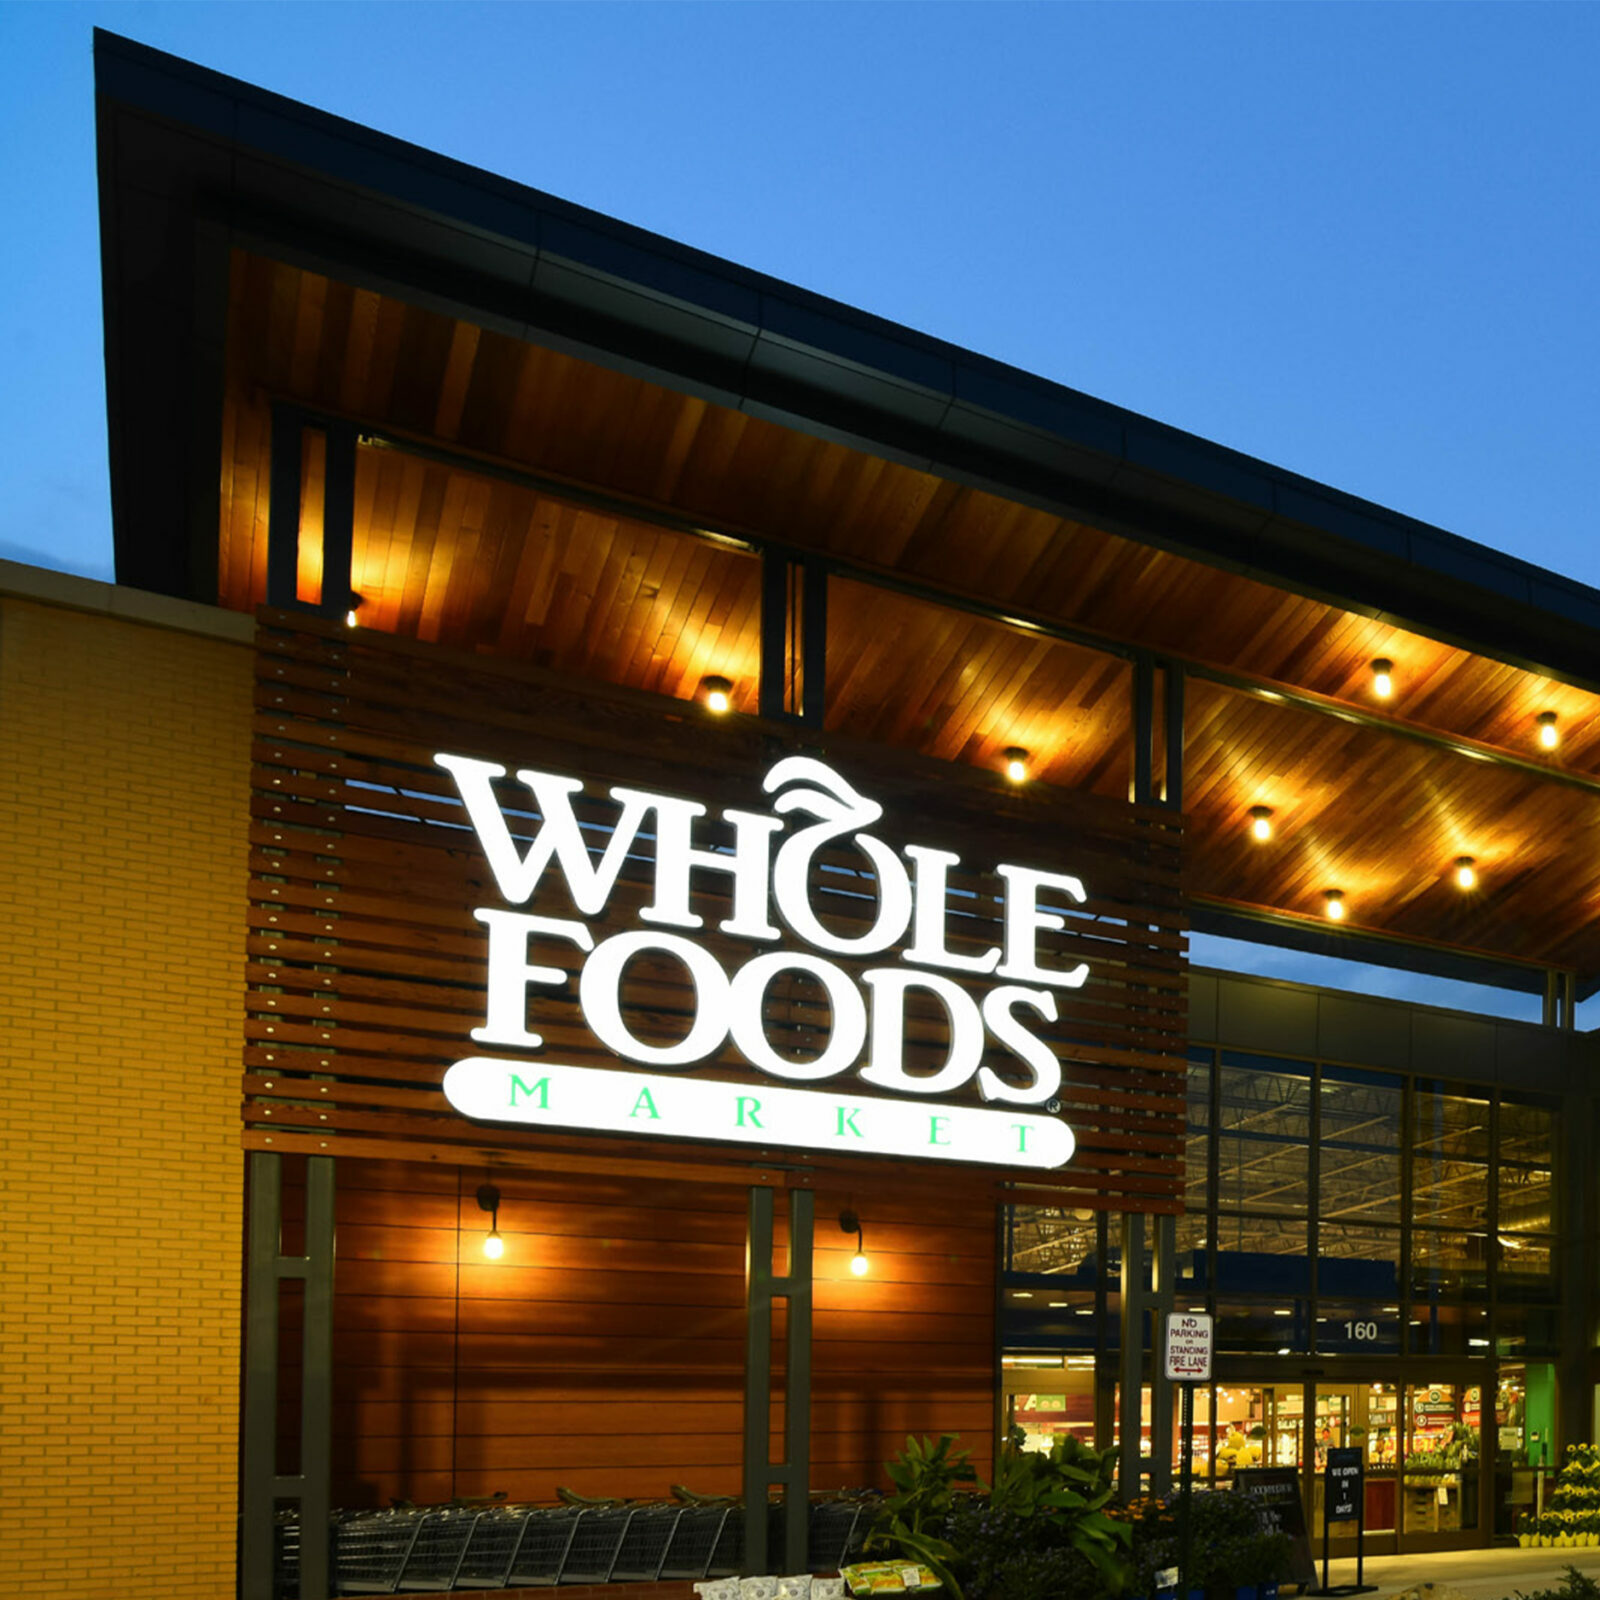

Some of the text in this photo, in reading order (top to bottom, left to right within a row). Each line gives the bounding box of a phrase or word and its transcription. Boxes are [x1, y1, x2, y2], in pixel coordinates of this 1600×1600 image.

[434, 753, 1090, 989] WHOLE
[470, 907, 1062, 1106] FOODS
[508, 1072, 1036, 1154] MARKET
[1181, 1319, 1197, 1328] NO
[1344, 1321, 1377, 1340] 160
[1170, 1329, 1208, 1339] PARKING
[1170, 1345, 1208, 1355] STANDING
[1169, 1356, 1207, 1367] FIRE LANE
